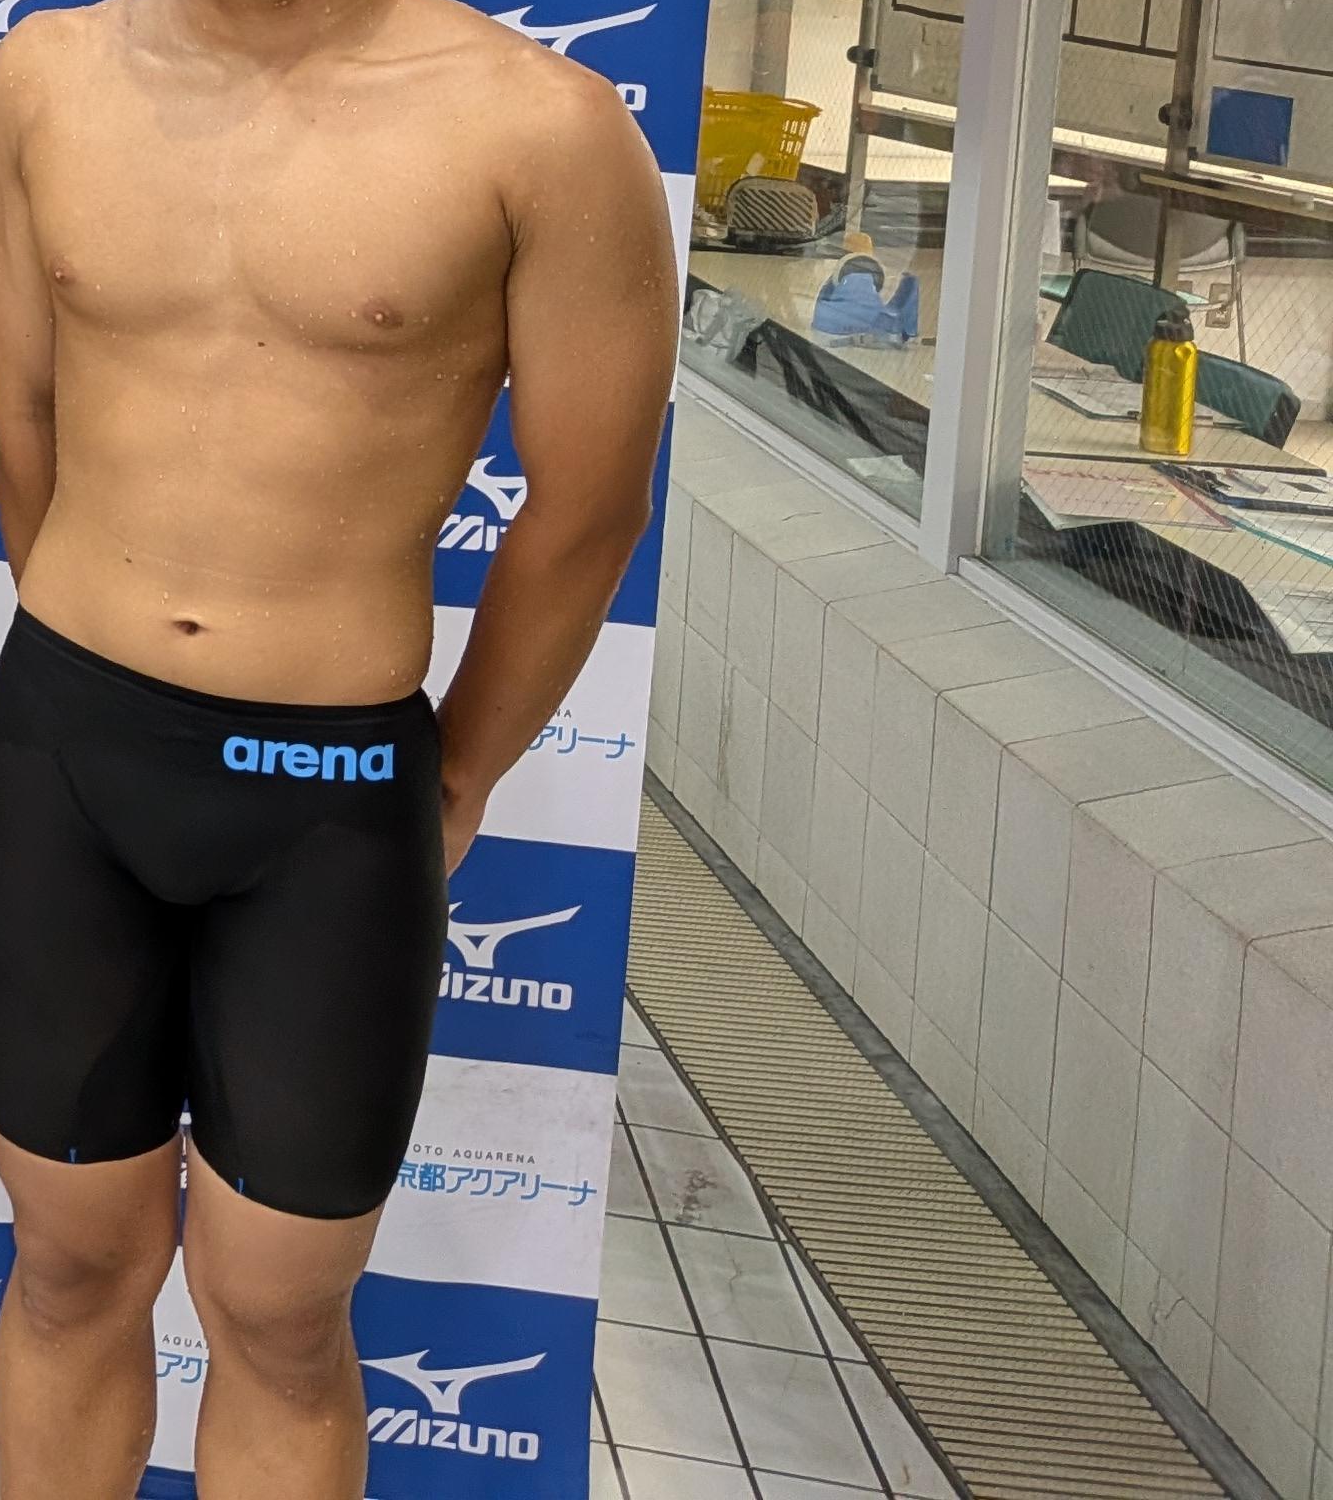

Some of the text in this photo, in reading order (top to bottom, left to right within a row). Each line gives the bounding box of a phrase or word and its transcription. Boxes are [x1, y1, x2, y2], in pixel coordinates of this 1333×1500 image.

[223, 735, 394, 781] arena
[438, 962, 572, 1011] IZUNO
[412, 1144, 536, 1164] OTO AQUARENA
[162, 1334, 204, 1349] AQUA
[367, 1407, 539, 1462] MIZUNO
